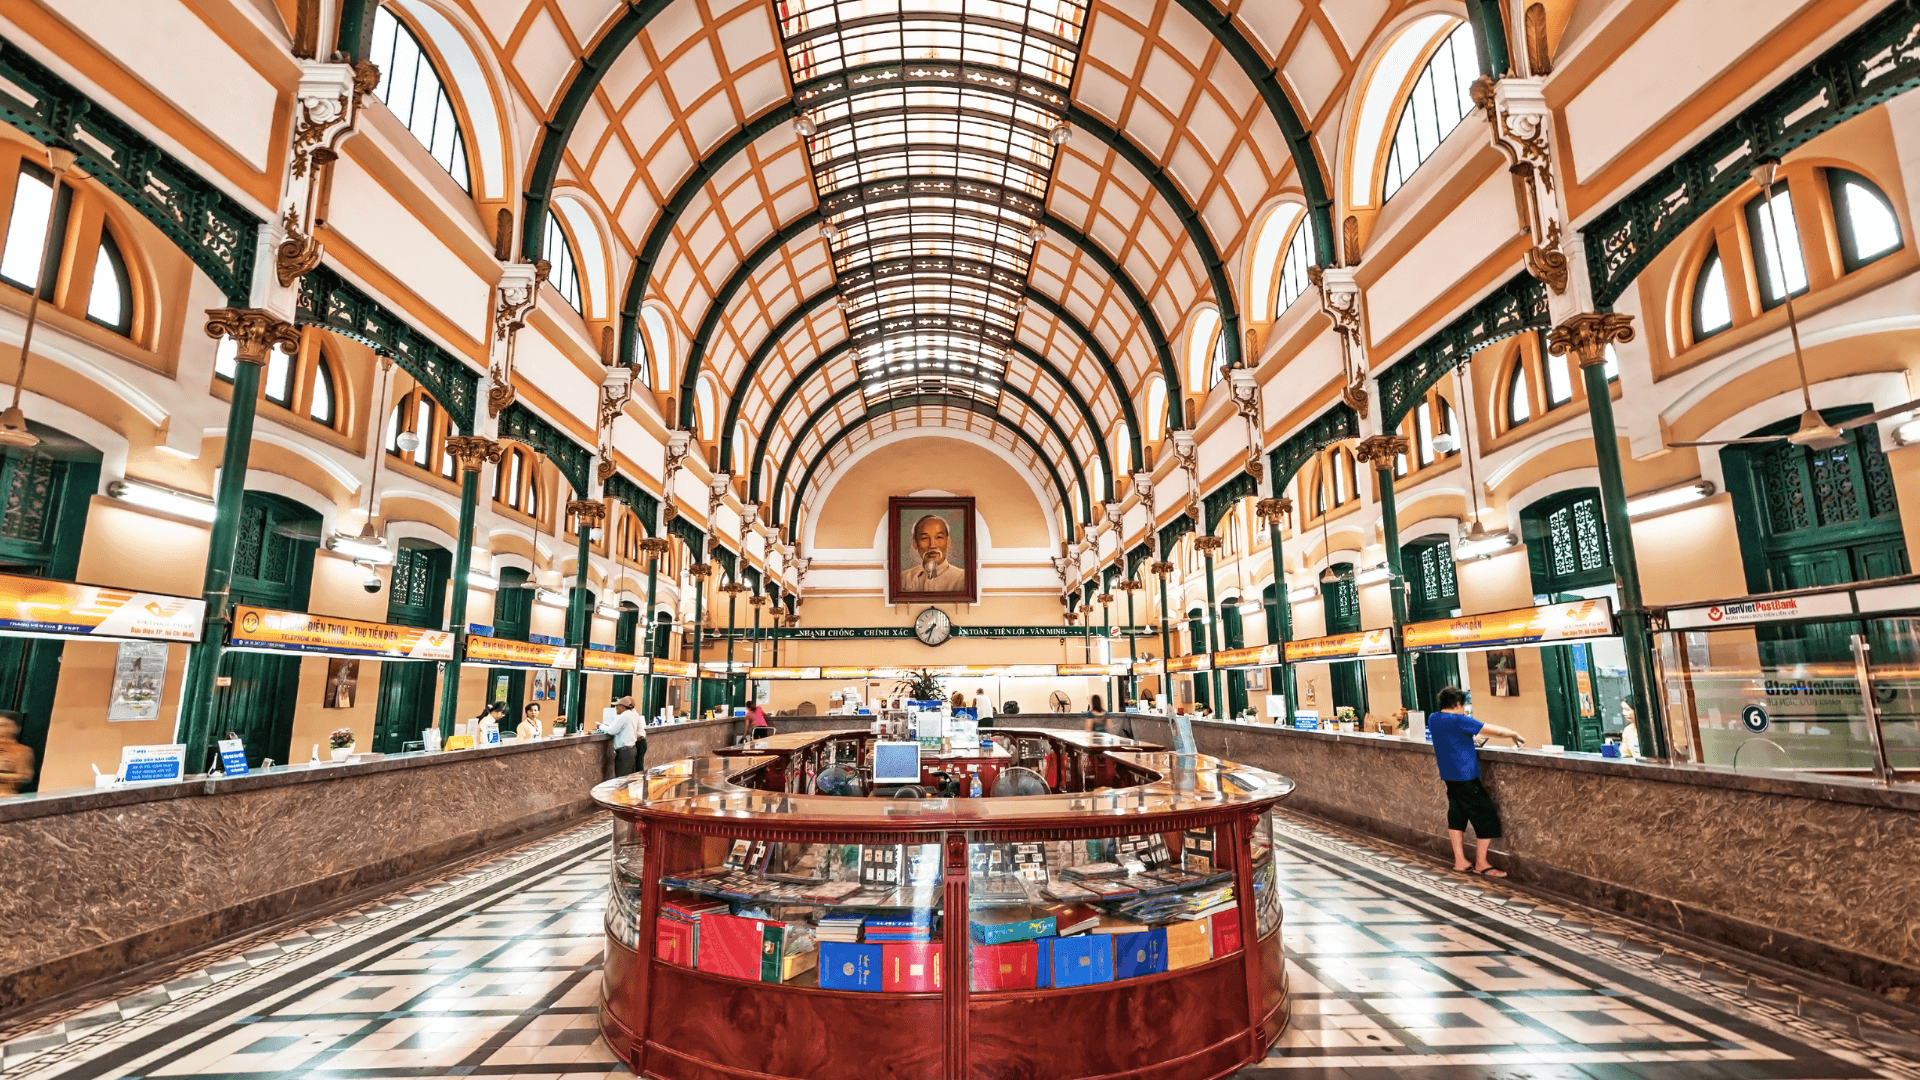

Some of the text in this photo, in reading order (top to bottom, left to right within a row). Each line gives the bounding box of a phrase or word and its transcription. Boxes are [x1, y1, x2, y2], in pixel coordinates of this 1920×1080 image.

[1724, 598, 1798, 615] LienVietPostBank
[245, 617, 257, 628] 12
[863, 628, 890, 637] CHÍNH
[892, 627, 909, 637] XÁC
[968, 627, 989, 636] TOÀN
[1046, 628, 1066, 636] MINH
[1749, 710, 1762, 727] 6
